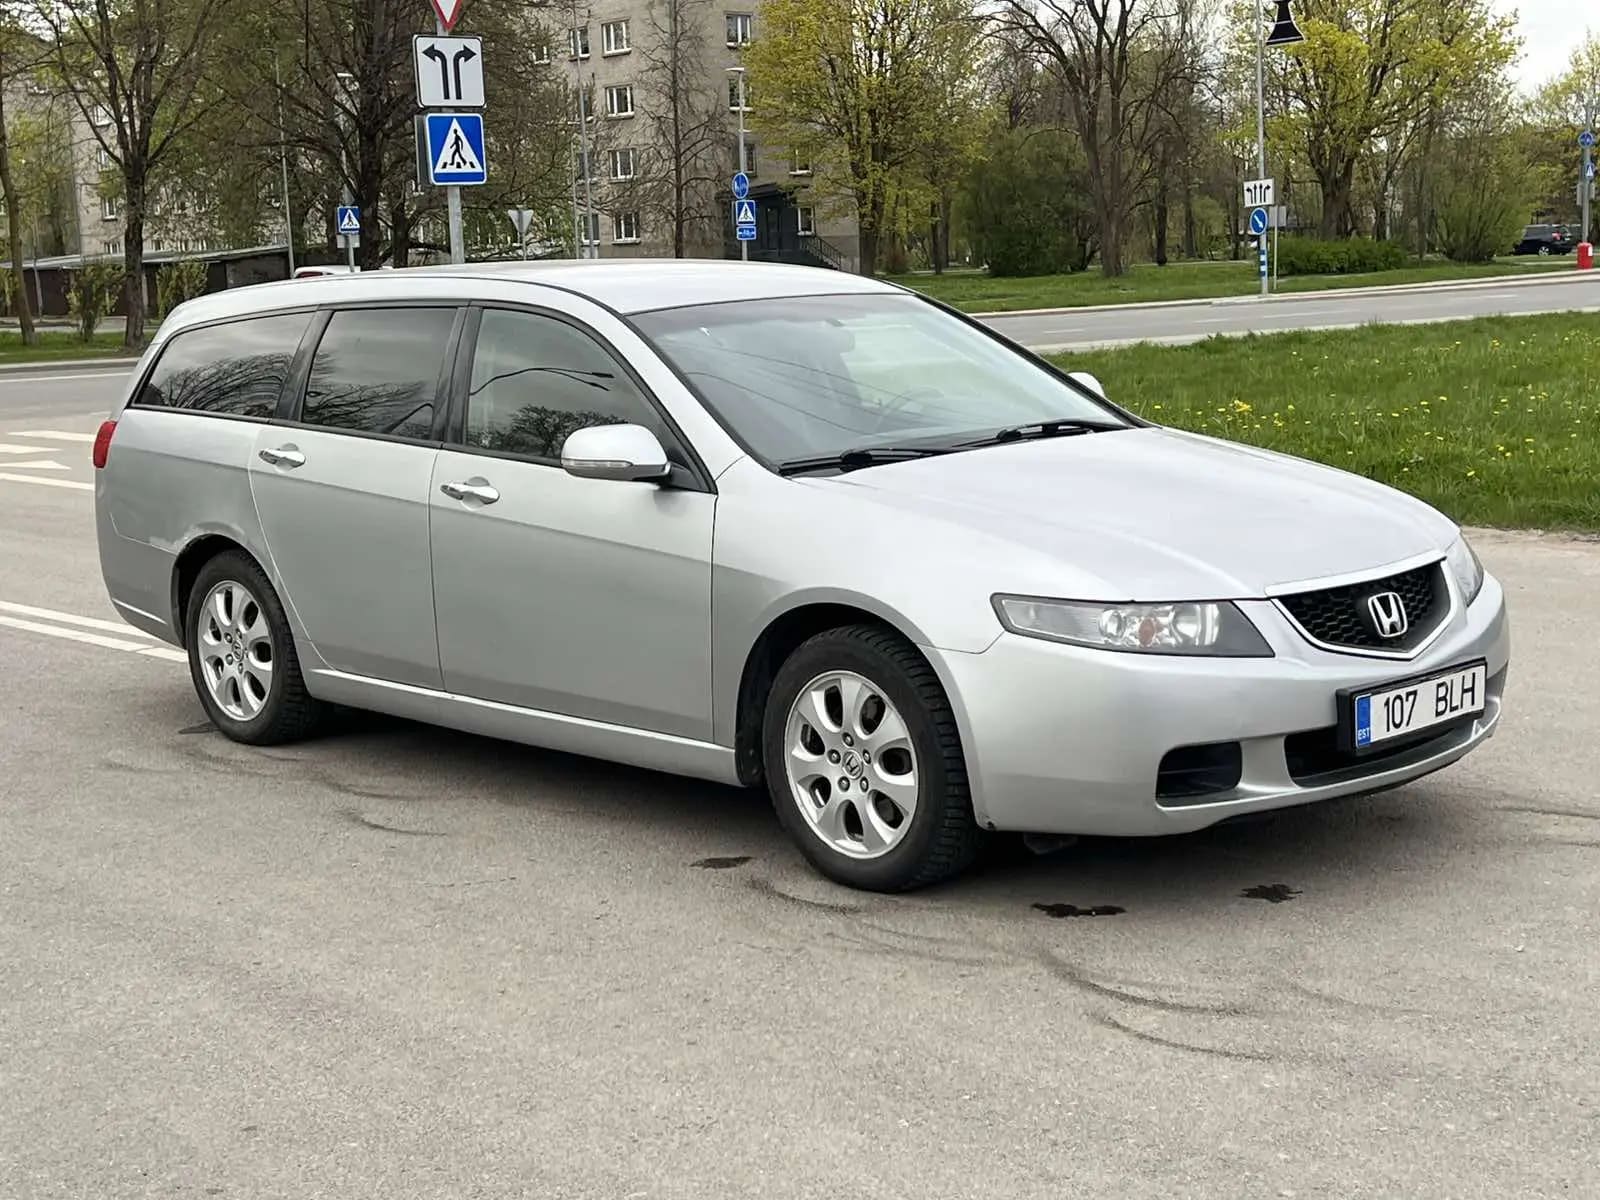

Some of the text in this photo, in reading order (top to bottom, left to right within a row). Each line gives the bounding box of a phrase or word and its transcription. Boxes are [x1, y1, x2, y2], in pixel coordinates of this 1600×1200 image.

[1384, 672, 1476, 732] 107 BLH
[1358, 727, 1370, 740] EST
